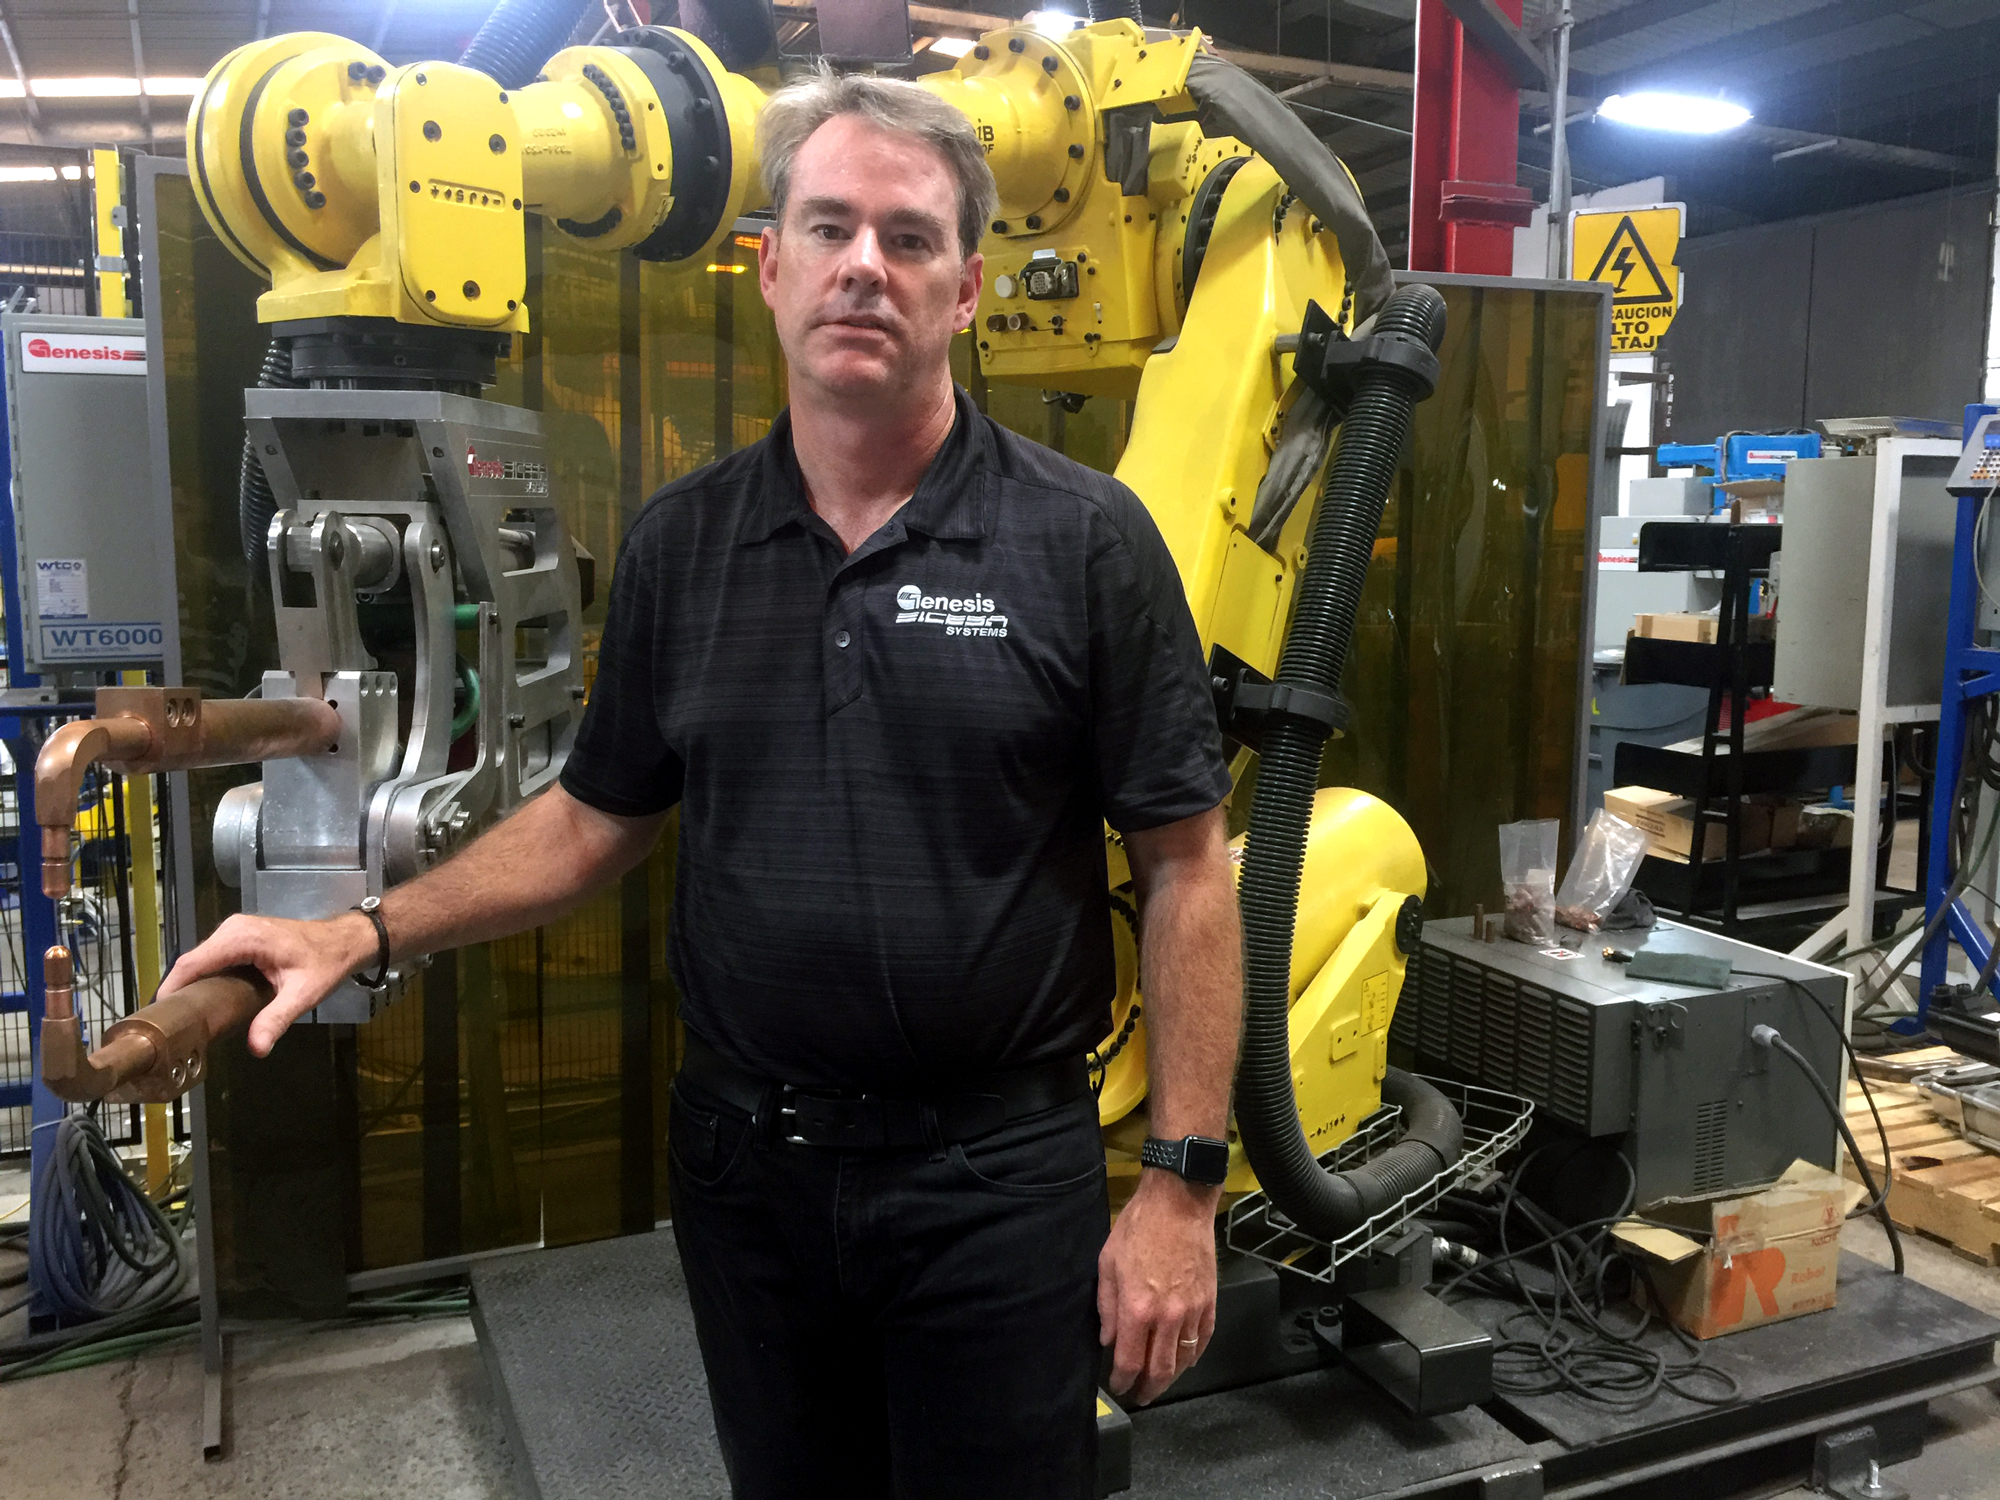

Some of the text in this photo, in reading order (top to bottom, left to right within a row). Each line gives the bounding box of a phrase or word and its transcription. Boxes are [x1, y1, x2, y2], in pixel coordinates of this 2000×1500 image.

[1611, 306, 1673, 320] AUCION
[1611, 321, 1649, 335] LTO
[28, 339, 122, 360] Genesis
[896, 584, 996, 613] Genesis
[51, 628, 163, 647] WT6000
[945, 626, 1008, 638] SYSTEMS
